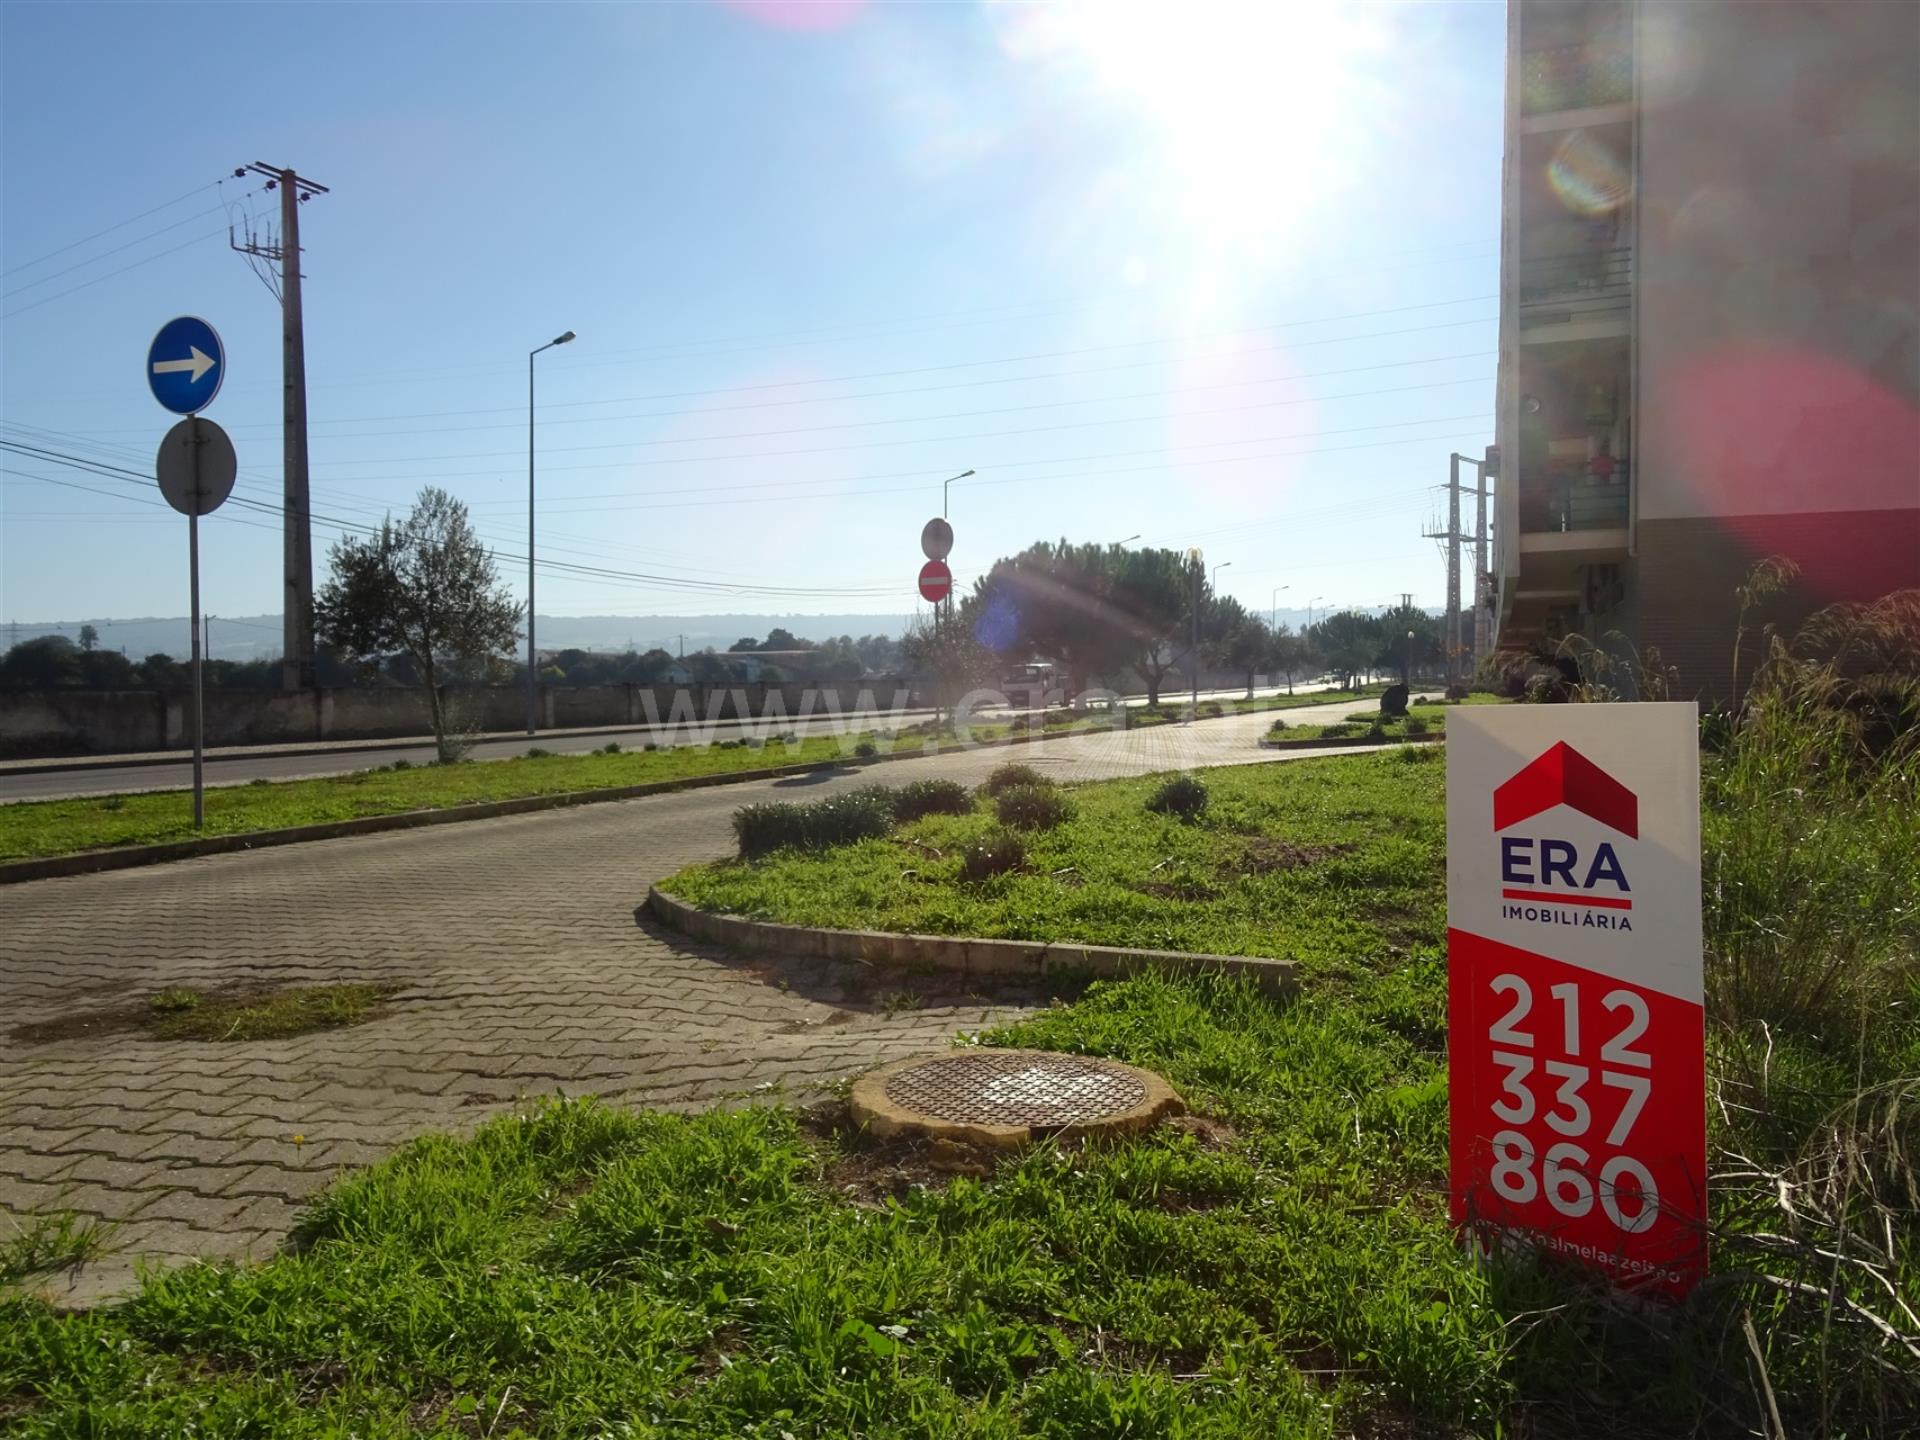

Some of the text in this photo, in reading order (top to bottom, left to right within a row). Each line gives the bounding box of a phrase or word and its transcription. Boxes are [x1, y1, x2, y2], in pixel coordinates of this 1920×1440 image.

[1501, 837, 1631, 891] ERA
[1502, 905, 1632, 931] IMOBILIÁRIA
[1489, 973, 1651, 1069] 212
[1490, 1050, 1651, 1146] 337
[1490, 1130, 1659, 1233] 860
